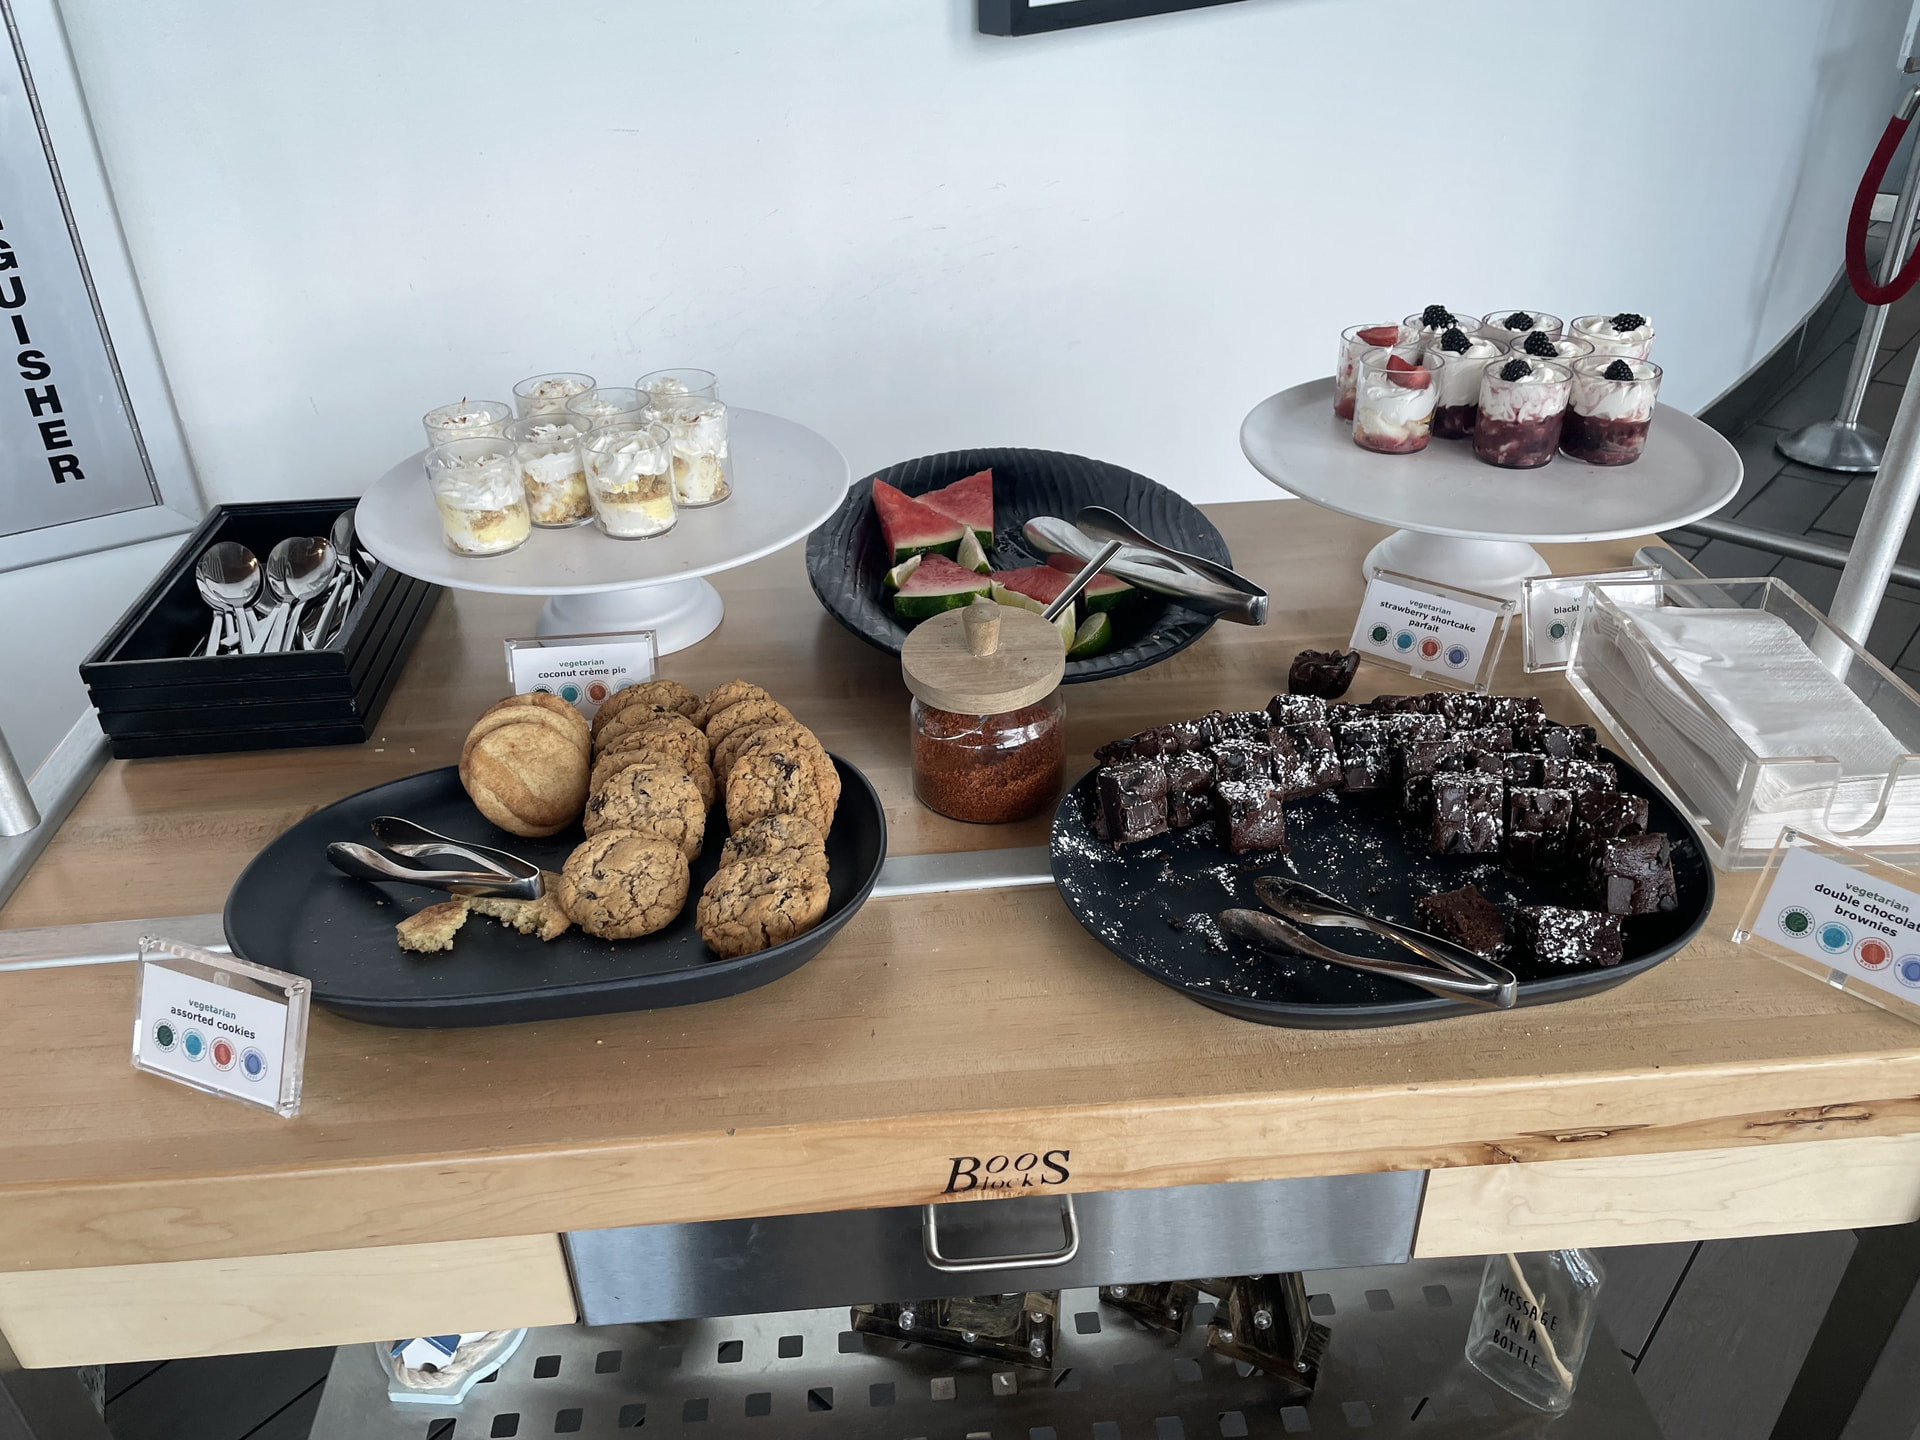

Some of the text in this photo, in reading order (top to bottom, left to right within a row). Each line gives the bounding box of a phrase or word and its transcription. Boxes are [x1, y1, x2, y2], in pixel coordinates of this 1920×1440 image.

[0, 219, 85, 484] GUISHER
[1380, 600, 1476, 633] strawberry shortcake
[1409, 599, 1452, 616] vegetarian
[1408, 619, 1440, 633] parfait
[538, 666, 627, 679] coconut crème pie
[558, 658, 605, 669] vegetarian
[1814, 883, 1920, 933] double chocolat
[1845, 882, 1910, 913] vegetarian
[1834, 904, 1898, 937] brownies
[170, 1005, 256, 1040] assorted cookies
[188, 998, 237, 1020] vegetarian
[1499, 1283, 1559, 1331] MESSAGE
[1505, 1314, 1537, 1344] IN A
[1493, 1329, 1540, 1369] BOTTLE
